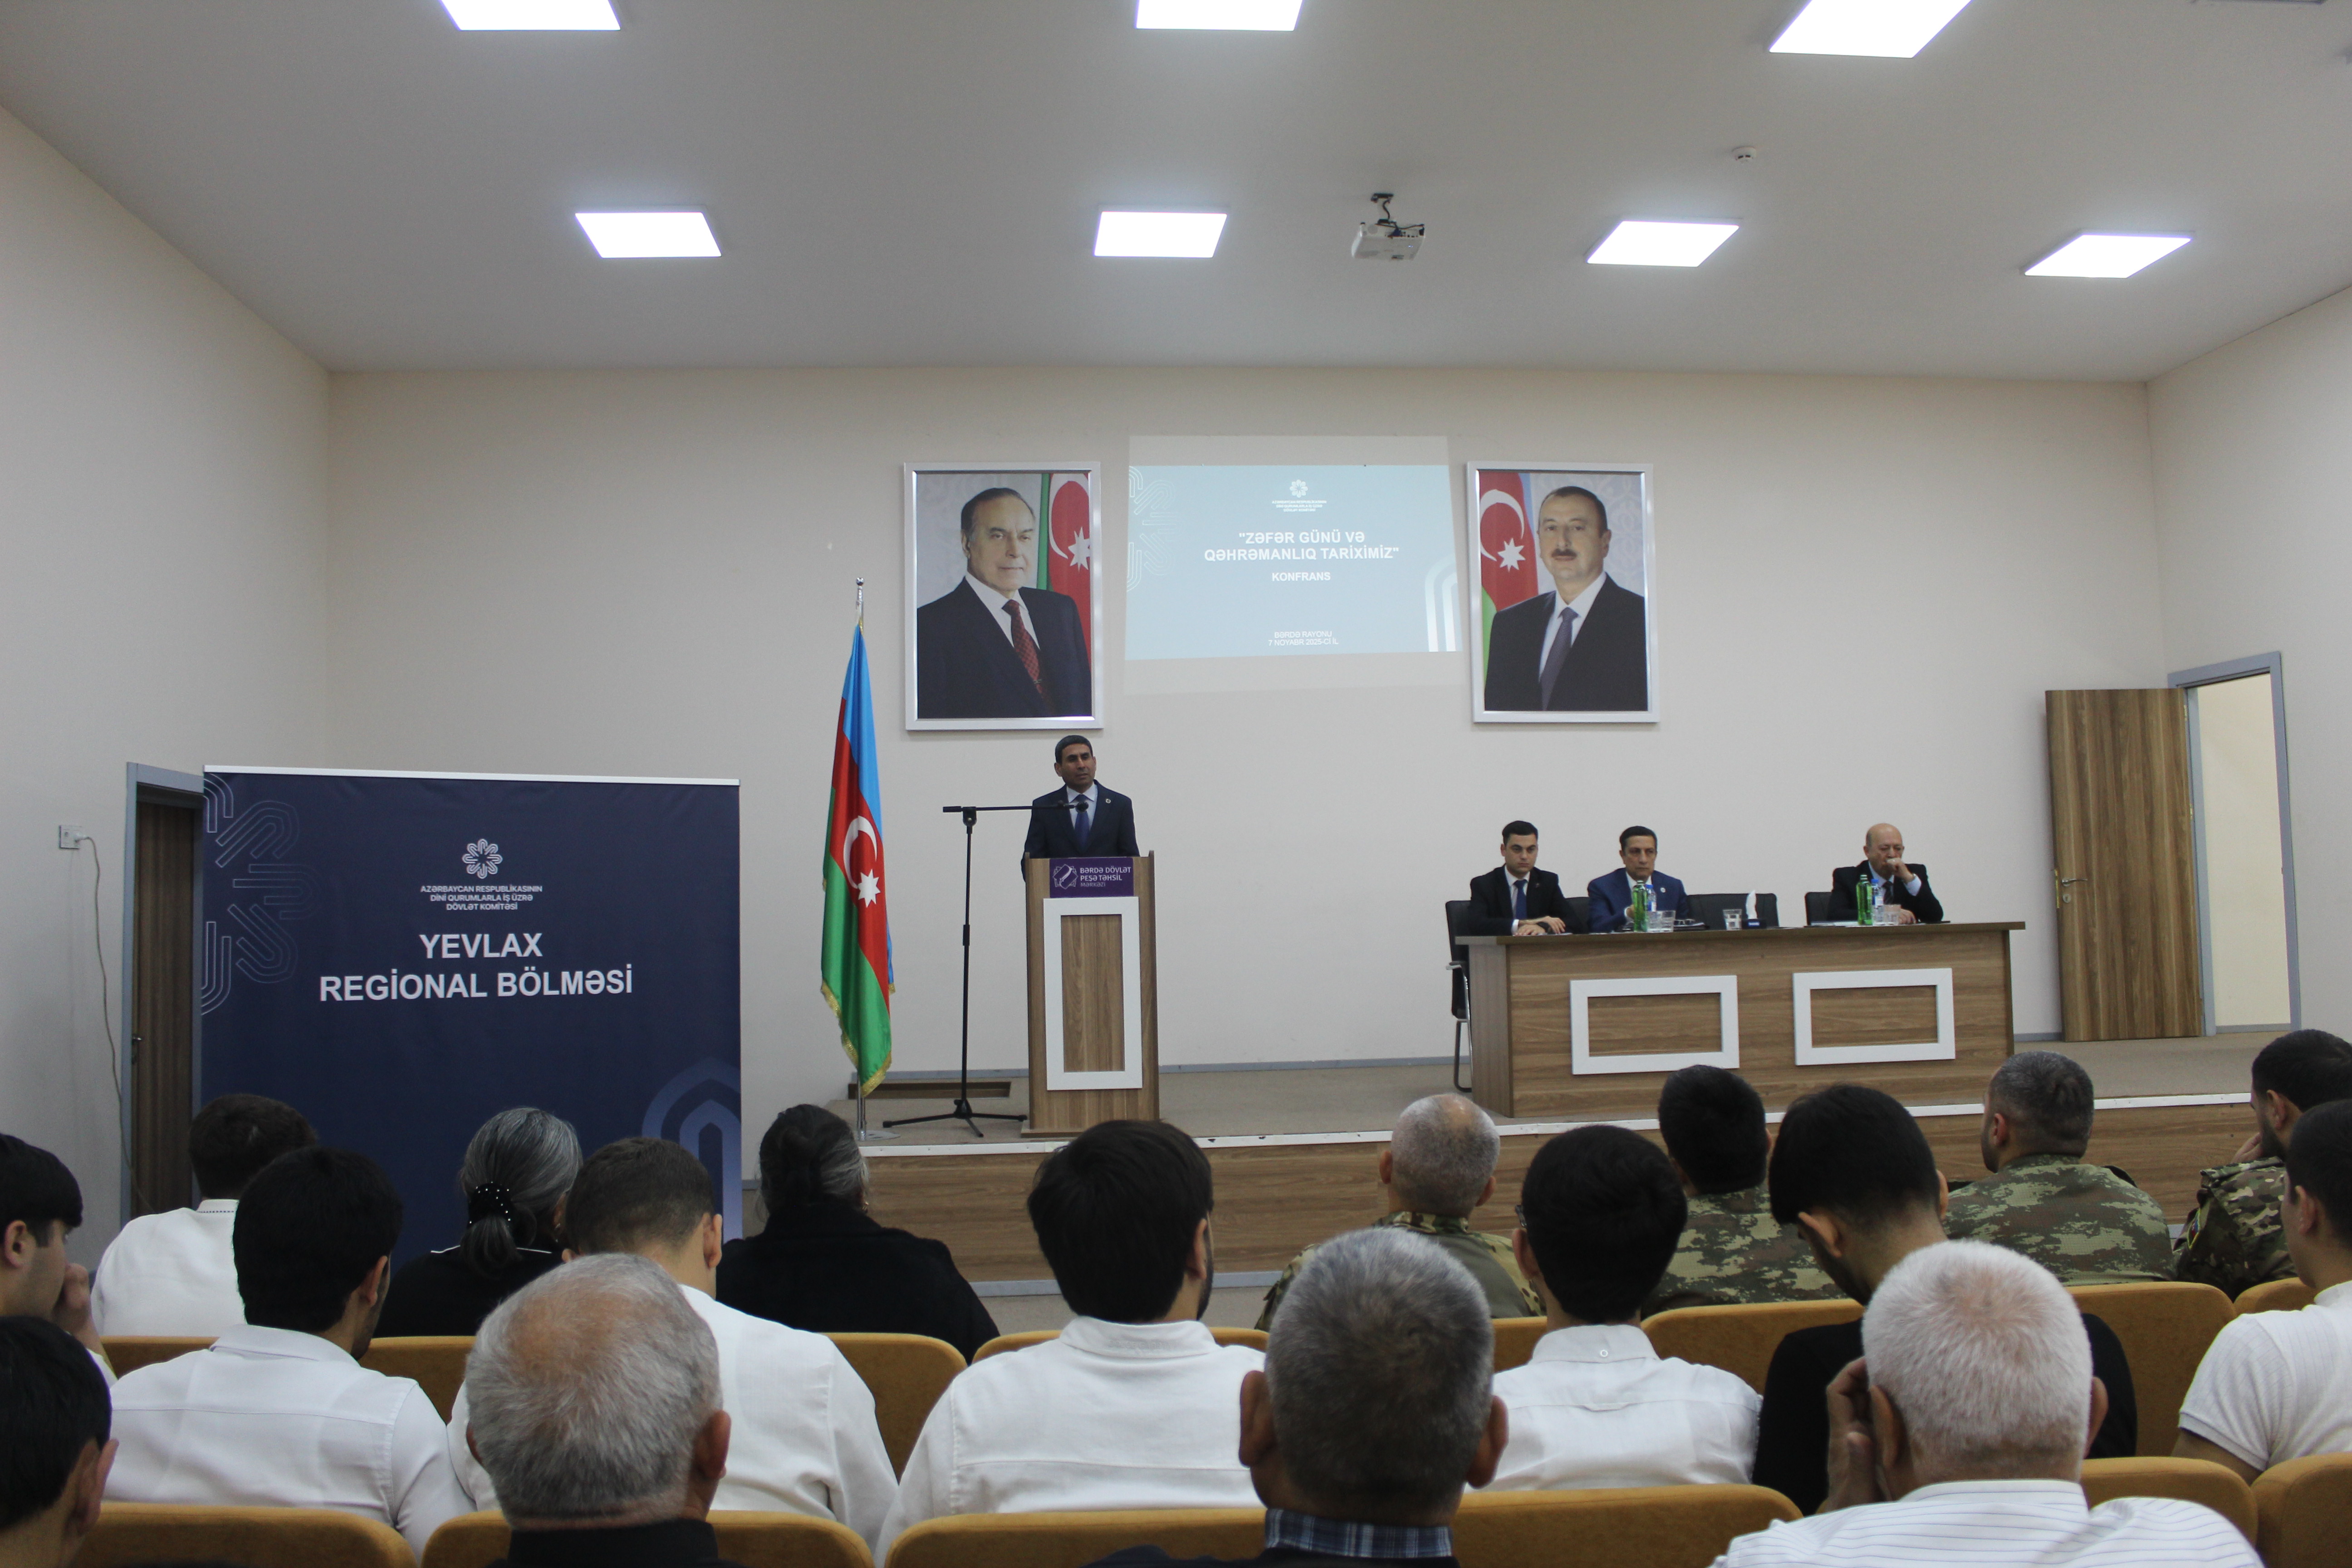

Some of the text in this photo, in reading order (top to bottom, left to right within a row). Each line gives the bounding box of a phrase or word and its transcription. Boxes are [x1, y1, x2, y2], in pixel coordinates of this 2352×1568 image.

[1239, 529, 1365, 544] "ZƏFƏR GÜNÜ VƏ
[1204, 545, 1399, 561] QƏHRƏMANLIQ TARİXİMİZ"
[1272, 572, 1331, 582] KONFRANS
[475, 884, 543, 892] RESPUBLİKASININ
[503, 894, 511, 902] İŞ
[419, 933, 543, 959] YEVLAX
[320, 964, 632, 1001] REGİONAL BÖLMƏSİ
